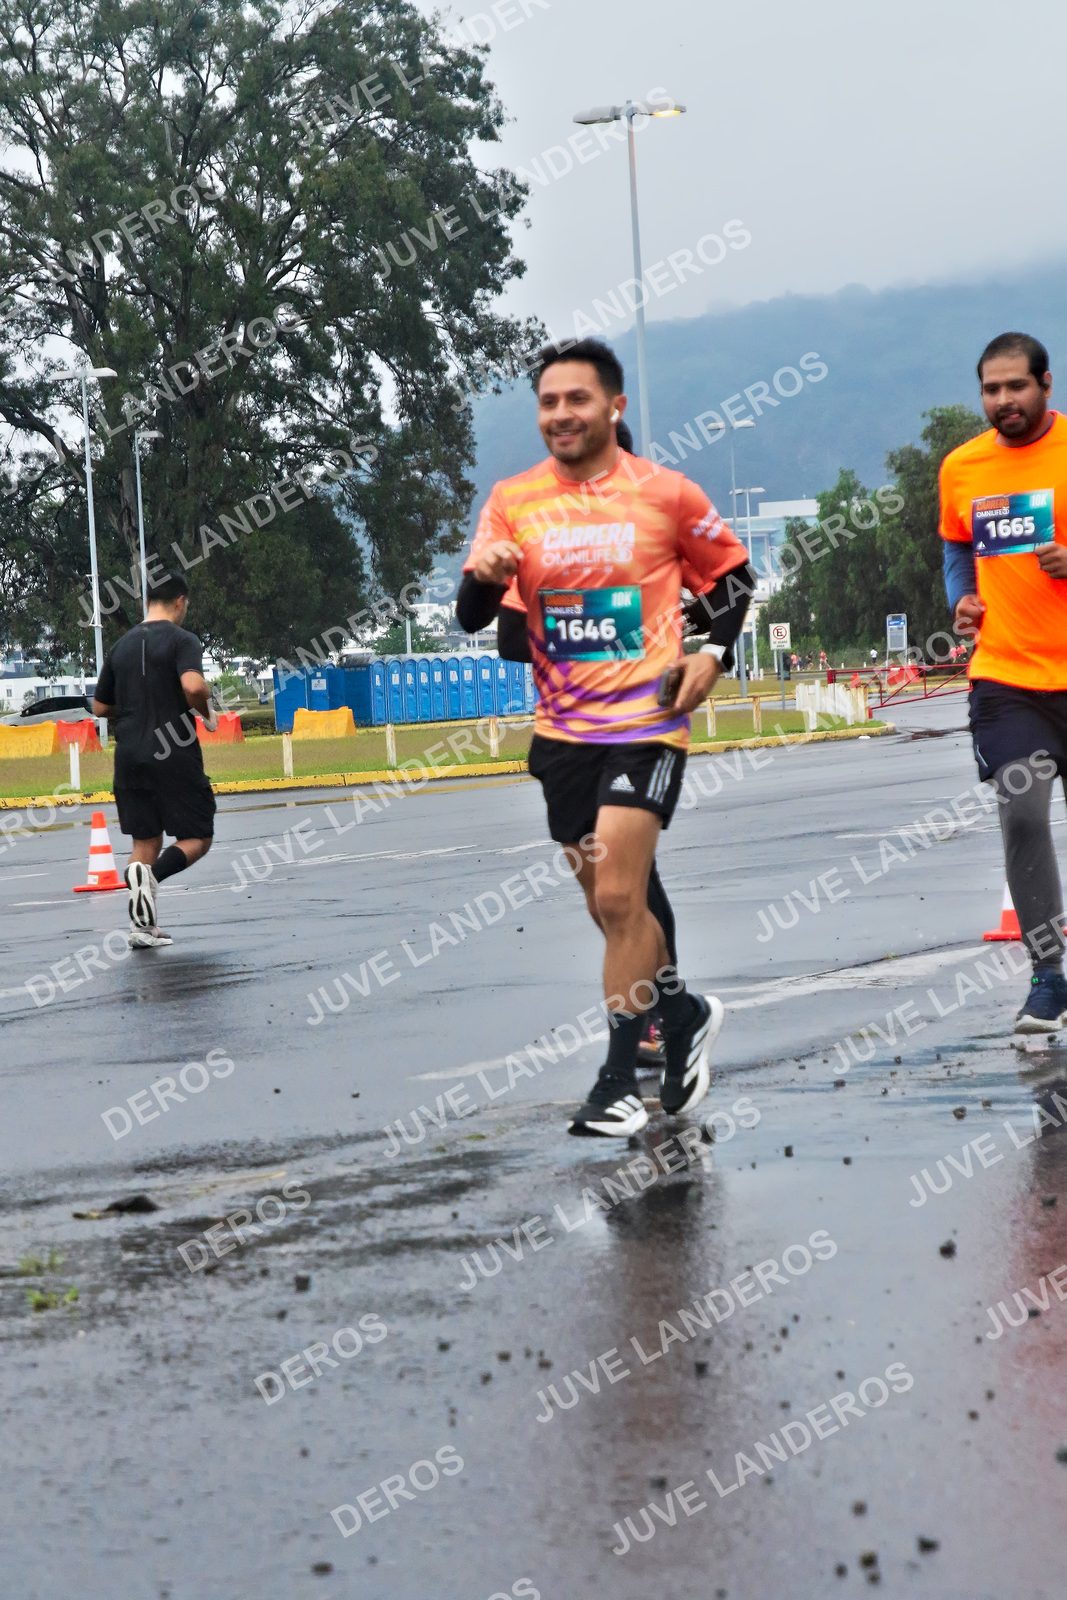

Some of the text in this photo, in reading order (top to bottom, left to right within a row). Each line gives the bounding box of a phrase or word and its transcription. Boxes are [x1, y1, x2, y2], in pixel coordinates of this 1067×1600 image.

[1030, 492, 1048, 508] 10K
[985, 516, 1035, 540] 1665
[611, 591, 633, 607] 10K
[556, 618, 617, 641] 1646
